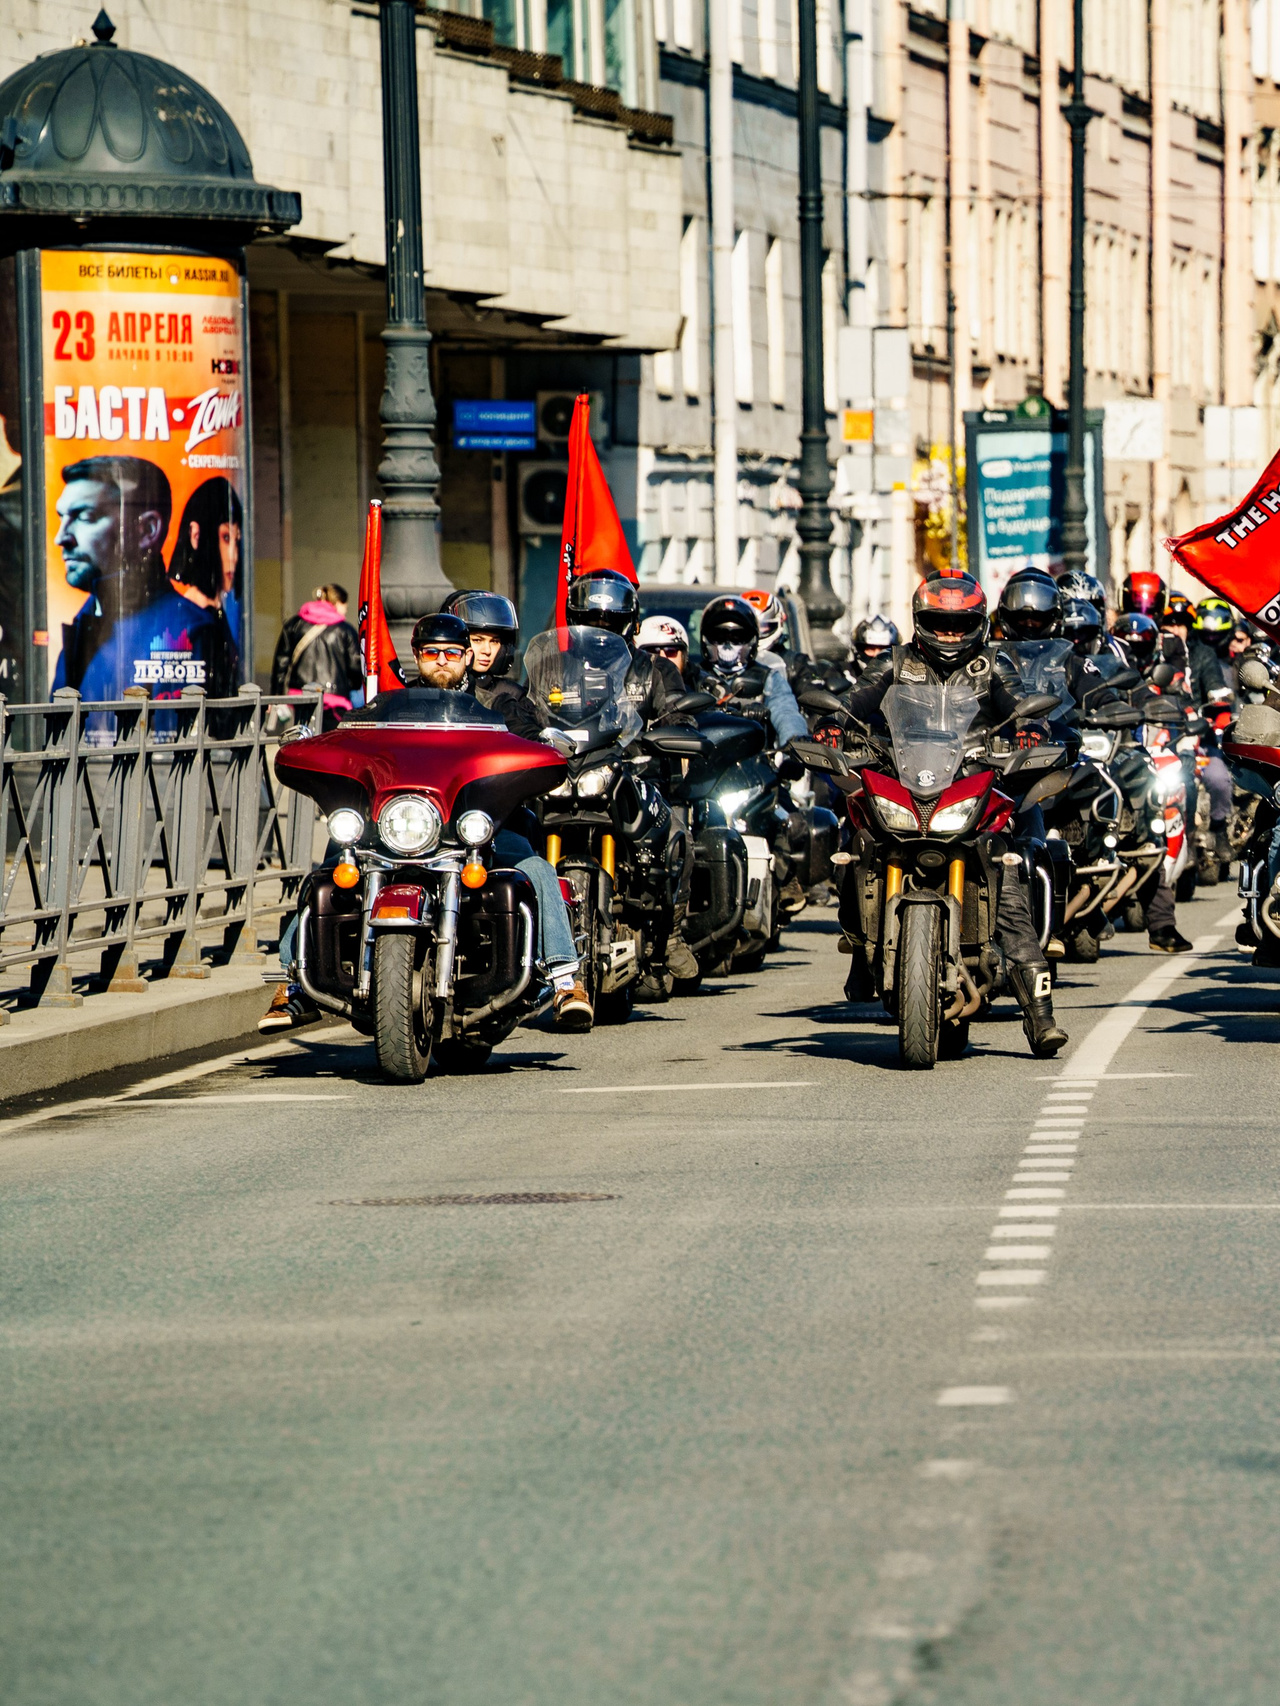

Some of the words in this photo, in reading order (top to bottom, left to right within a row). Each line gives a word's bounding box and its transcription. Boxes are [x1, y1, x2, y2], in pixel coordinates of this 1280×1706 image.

[79, 265, 103, 278] ВСЕ
[107, 266, 162, 279] БИЛЕТЫ
[53, 310, 95, 361] 23
[108, 312, 192, 344] АПРЕЛЯ
[54, 385, 170, 441] БАСТА
[1214, 505, 1269, 549] THE
[134, 664, 206, 679] ЛЮБОВЬ
